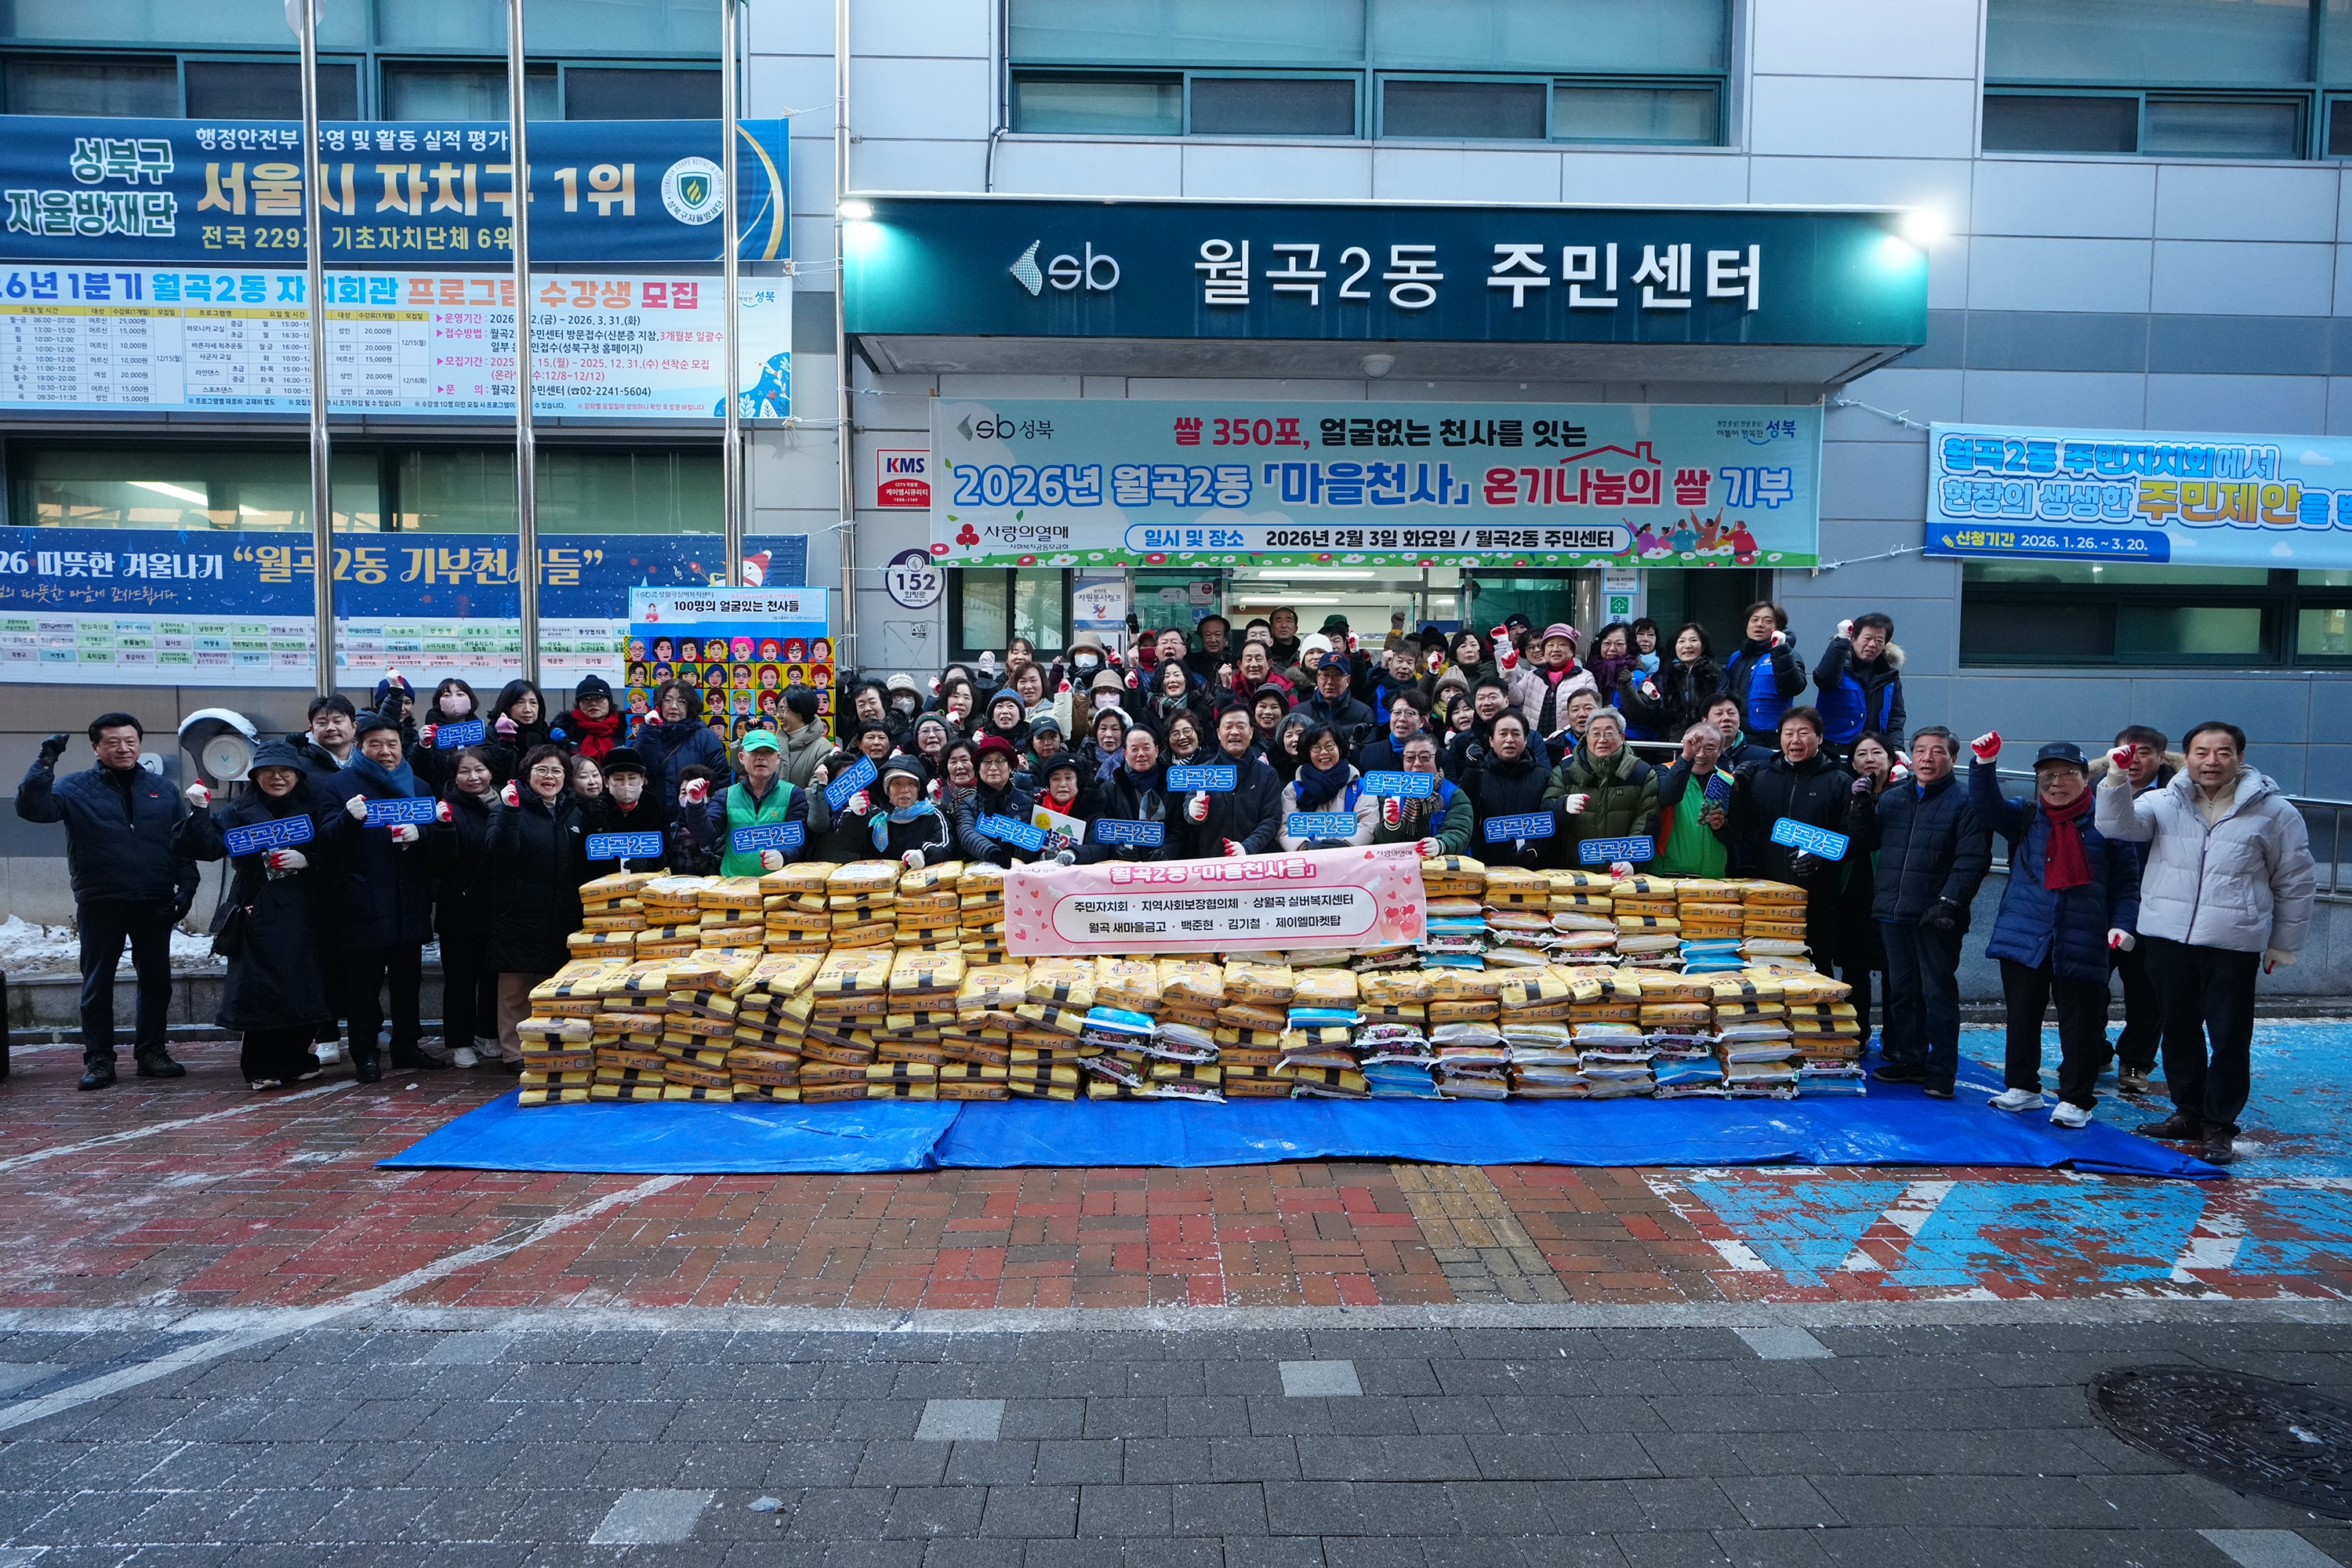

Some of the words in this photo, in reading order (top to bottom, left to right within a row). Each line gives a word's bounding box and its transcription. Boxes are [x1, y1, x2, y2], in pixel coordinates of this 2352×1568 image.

[196, 128, 299, 151] 행정안전부
[351, 129, 370, 151] 및
[376, 129, 418, 151] 활동
[423, 129, 461, 151] 실적
[467, 129, 508, 152] 평가
[71, 136, 174, 185] 성북구
[675, 159, 691, 170] CORPS
[692, 159, 710, 169] ACTIVE
[198, 162, 356, 216] 서울시
[376, 162, 534, 217] 자치구
[554, 163, 635, 216] 1위
[5, 189, 178, 237] 자율방재단
[202, 226, 246, 249] 전국
[256, 227, 307, 249] 229
[332, 225, 468, 252] 기초자치단체
[477, 227, 513, 251] 6위
[1048, 241, 1120, 291] sb
[1195, 238, 1444, 310] 월곡2동
[1487, 243, 1760, 311] 주민센터
[68, 273, 142, 300] 1분기
[152, 273, 267, 303] 월곡2동
[540, 280, 631, 310] 수강생
[641, 281, 699, 309] 모집
[755, 291, 775, 303] 성북
[365, 327, 391, 336] 20,000원
[445, 314, 482, 323] 운영기간
[568, 315, 596, 325] 2026.
[609, 316, 641, 326] 31.(화)
[120, 342, 147, 350] 10,000원
[445, 328, 482, 339] 접수방법
[567, 330, 635, 342] 방문접수(신분증
[365, 343, 392, 352] 20,000원
[365, 355, 392, 364] 15,000원
[491, 343, 510, 353] 일부
[602, 343, 643, 354] 홈페이지)
[445, 358, 483, 367] 모집기간
[580, 358, 608, 368] 2025.
[627, 359, 659, 370] 31.(수)
[661, 359, 689, 369] 선착순
[691, 359, 710, 370] 모집
[976, 413, 1016, 440] sb
[1018, 419, 1054, 440] 성북
[1174, 417, 1203, 446] 쌀
[1212, 418, 1310, 450] 350포,
[1319, 417, 1432, 447] 얼굴없는
[1439, 419, 1523, 447] 천사를
[1532, 420, 1588, 448] 잇는
[1717, 430, 1739, 438] 더불어
[1741, 430, 1763, 439] 행복한
[1766, 419, 1796, 438] 성북
[887, 457, 925, 474] KMS
[1944, 437, 2057, 473] 월곡2동
[2063, 443, 2276, 479] 주민자치회에서
[953, 464, 1102, 507] 2026년
[1111, 464, 1252, 508] 월곡2동
[1483, 467, 1661, 506] 온기나눔의
[1673, 467, 1711, 506] 쌀
[1719, 466, 1794, 509] 기부
[1943, 481, 2032, 514] 현장의
[2040, 483, 2132, 517] 생생한
[2138, 480, 2330, 525] 주민제안을
[984, 524, 1069, 539] 사랑의열매
[1144, 529, 1179, 548] 일시
[1186, 530, 1203, 548] 및
[1210, 529, 1244, 548] 장소
[1265, 529, 1330, 548] 2026년
[1334, 530, 1365, 548] 2월
[1369, 530, 1397, 548] 3일
[1403, 529, 1456, 548] 화요일
[1475, 530, 1539, 549] 월곡2동
[1544, 530, 1613, 549] 주민센터
[1955, 531, 2015, 548] 신청기간
[2021, 535, 2060, 548] 2026.
[2063, 536, 2075, 549] 1.
[2078, 536, 2099, 549] 26.
[2111, 537, 2125, 550] 3.
[2127, 538, 2147, 550] 20.
[37, 551, 115, 578] 따뜻한
[122, 552, 223, 579] 겨울나기
[897, 573, 936, 590] 152
[21, 583, 65, 604] 따뜻한
[70, 585, 105, 603] 마음에
[111, 586, 179, 606] 감사드립니다.
[674, 600, 717, 613] 100명의
[720, 600, 763, 613] 얼굴있는
[767, 600, 800, 613] 천사들
[1078, 593, 1122, 602] 자원봉사캠프
[437, 721, 484, 747] 월곡2동
[826, 758, 877, 809] 월곡2동
[1168, 767, 1236, 790] 월곡2동
[1365, 772, 1432, 798] 월곡2동
[366, 800, 434, 824] 월곡2동
[227, 818, 310, 852] 월곡2동
[734, 823, 804, 848] 월곡2동
[978, 813, 1045, 848] 월곡2동
[1098, 821, 1163, 845] 월곡2동
[1288, 813, 1356, 836] 월곡2동
[1486, 814, 1555, 842] 월곡2동
[589, 833, 661, 858] 월곡2동
[1580, 838, 1653, 864] 월곡2동
[1773, 820, 1847, 859] 월곡2동
[1109, 864, 1188, 884] 월곡2동
[1074, 899, 1128, 913] 주민자치회
[1141, 897, 1239, 911] 지역사회보장협의체
[1253, 895, 1286, 909] 상월곡
[1288, 893, 1354, 908] 실버복지센터
[1089, 920, 1111, 934] 월곡
[1112, 919, 1167, 933] 새마을금고
[1180, 916, 1214, 931] 백준현
[1228, 916, 1261, 931] 김기철
[1275, 914, 1341, 929] 제이엘마켓탑
